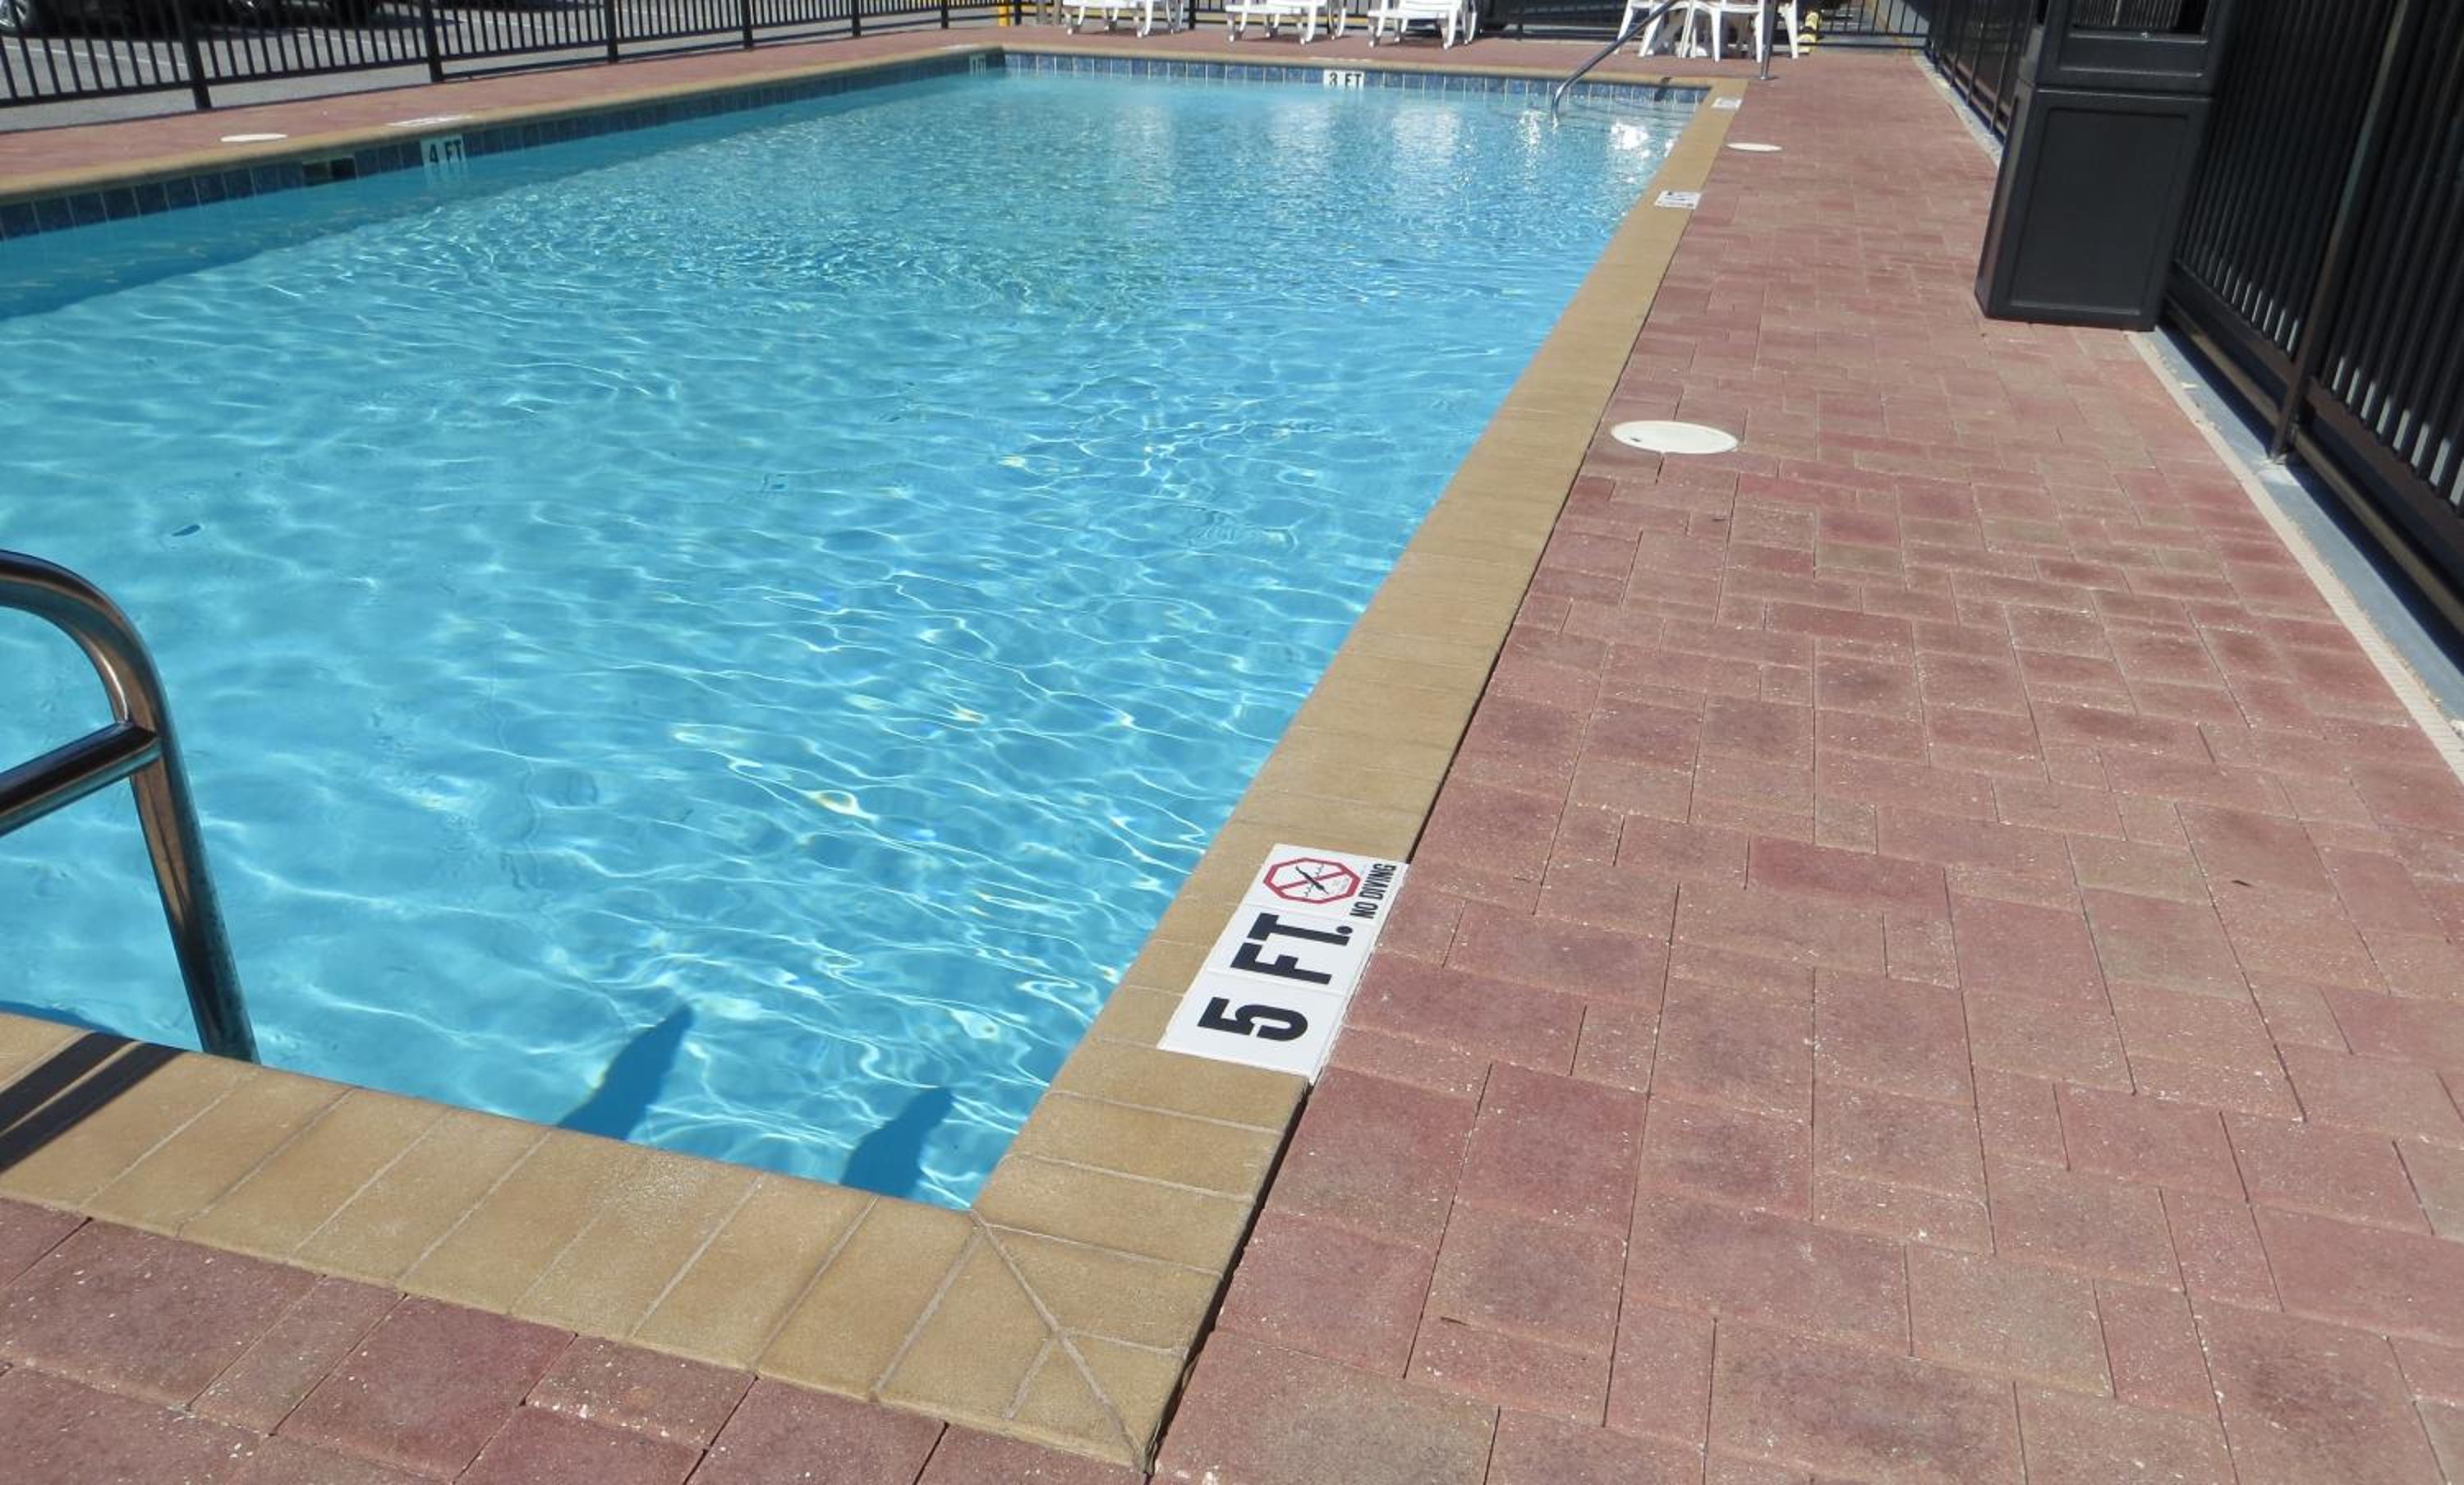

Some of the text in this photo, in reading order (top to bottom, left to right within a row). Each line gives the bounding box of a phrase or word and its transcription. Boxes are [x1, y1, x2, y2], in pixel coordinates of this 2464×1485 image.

[1329, 71, 1362, 88] 3 FT
[430, 140, 462, 163] 4 FT
[1349, 863, 1397, 919] NO DIVING
[1197, 913, 1354, 1042] 5 FT.
